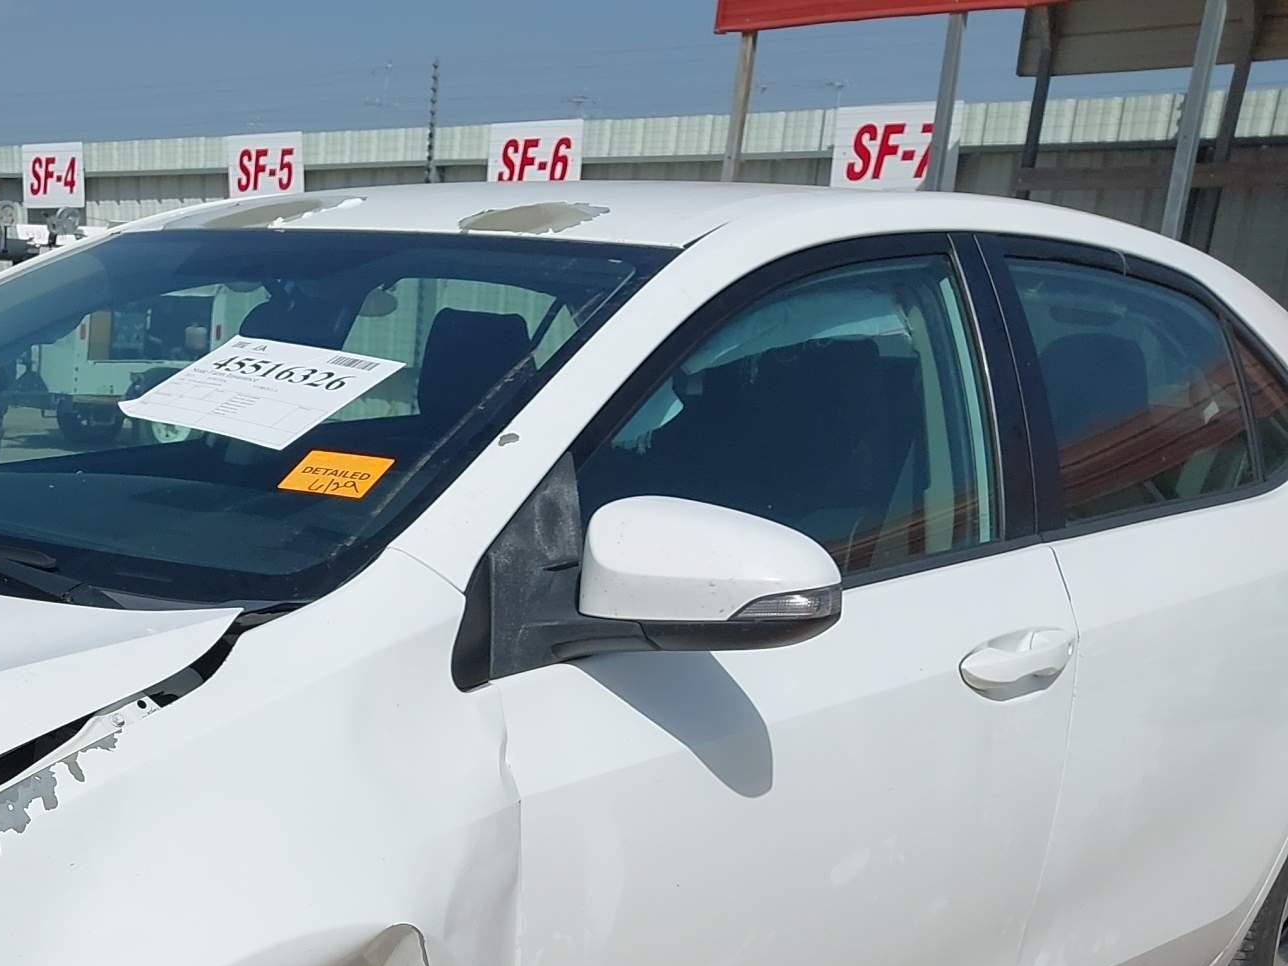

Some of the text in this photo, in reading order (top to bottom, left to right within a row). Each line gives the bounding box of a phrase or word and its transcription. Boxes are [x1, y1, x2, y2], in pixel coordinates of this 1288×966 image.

[30, 156, 76, 195] SF-4
[237, 147, 295, 192] SF-5
[498, 137, 573, 182] SF-6
[212, 355, 356, 391] 45516326
[301, 466, 371, 481] DETAILED
